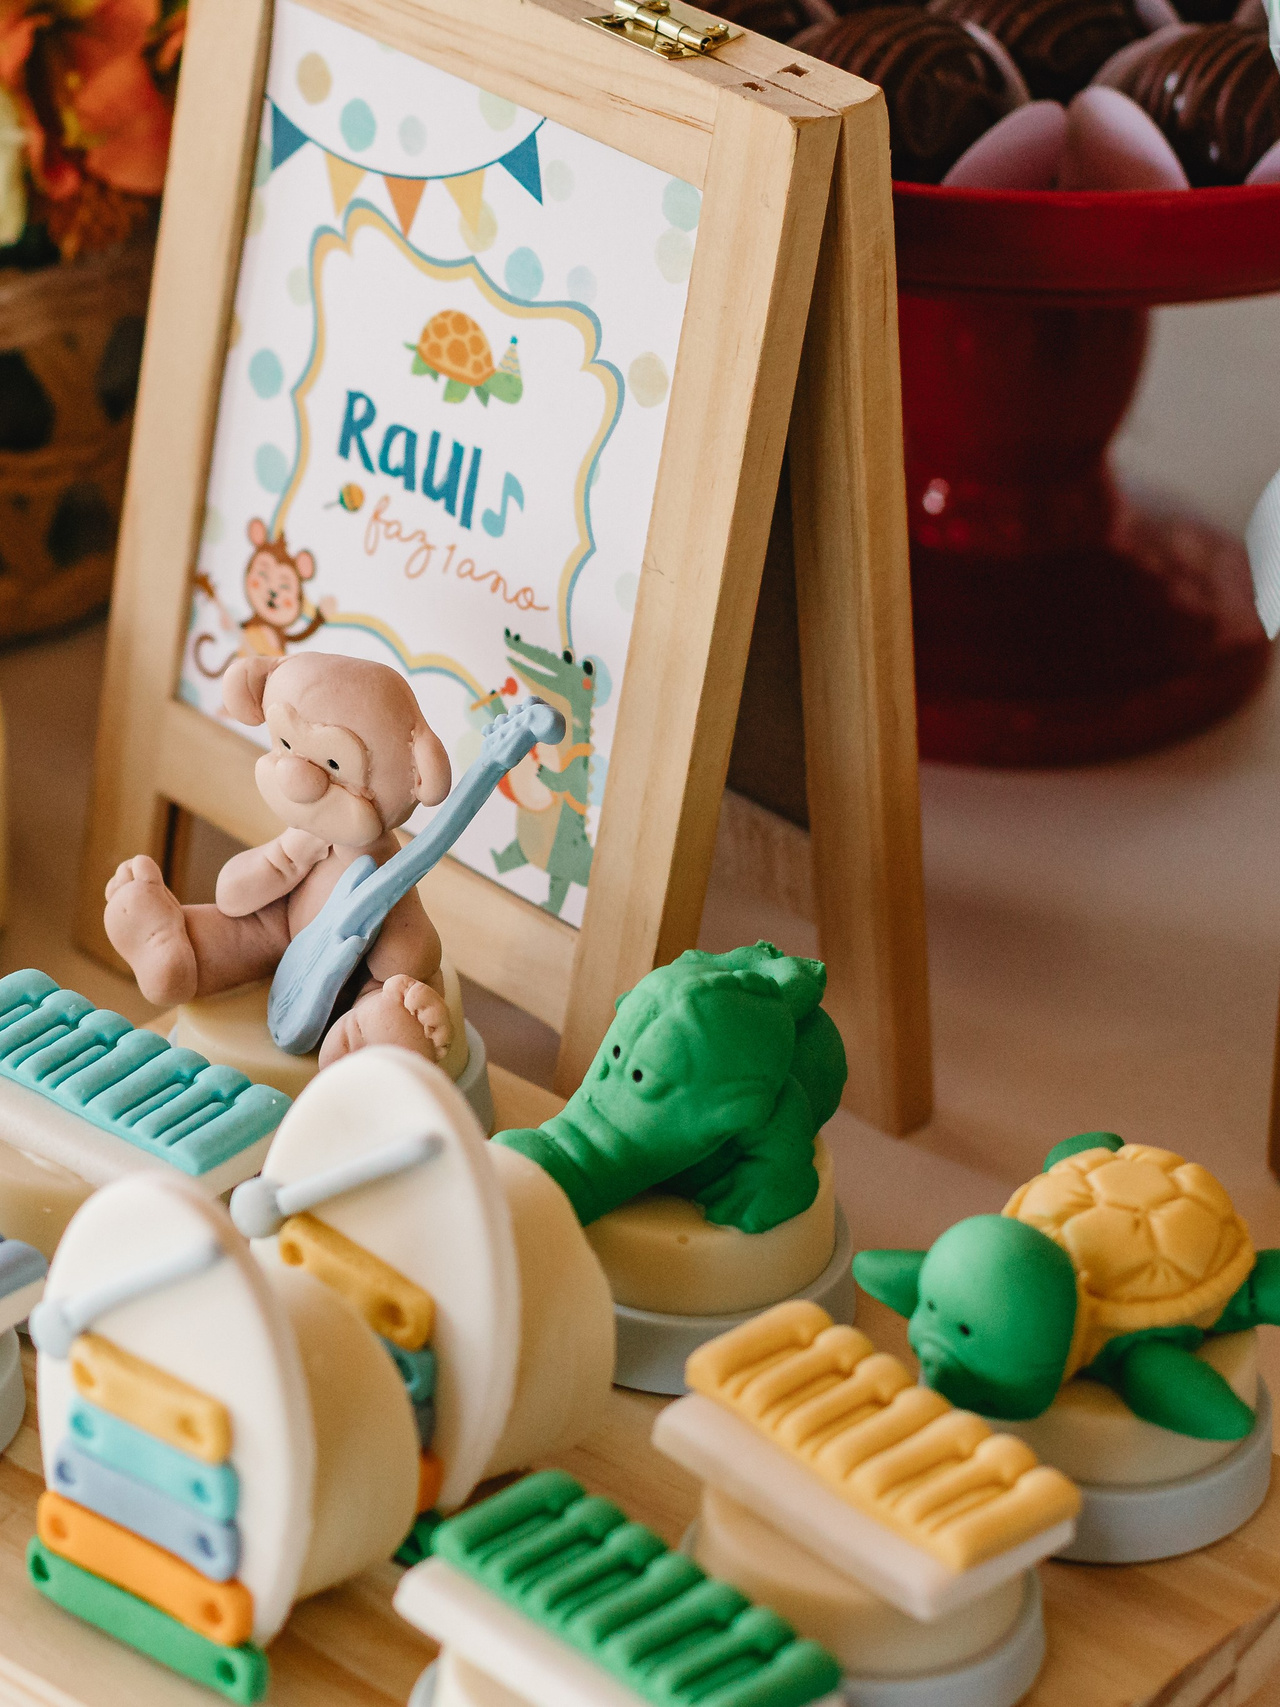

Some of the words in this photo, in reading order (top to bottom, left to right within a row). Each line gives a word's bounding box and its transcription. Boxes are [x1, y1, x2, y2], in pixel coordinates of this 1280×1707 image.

[337, 389, 483, 531] Raul
[363, 495, 437, 580] faz
[456, 558, 550, 611] ano
